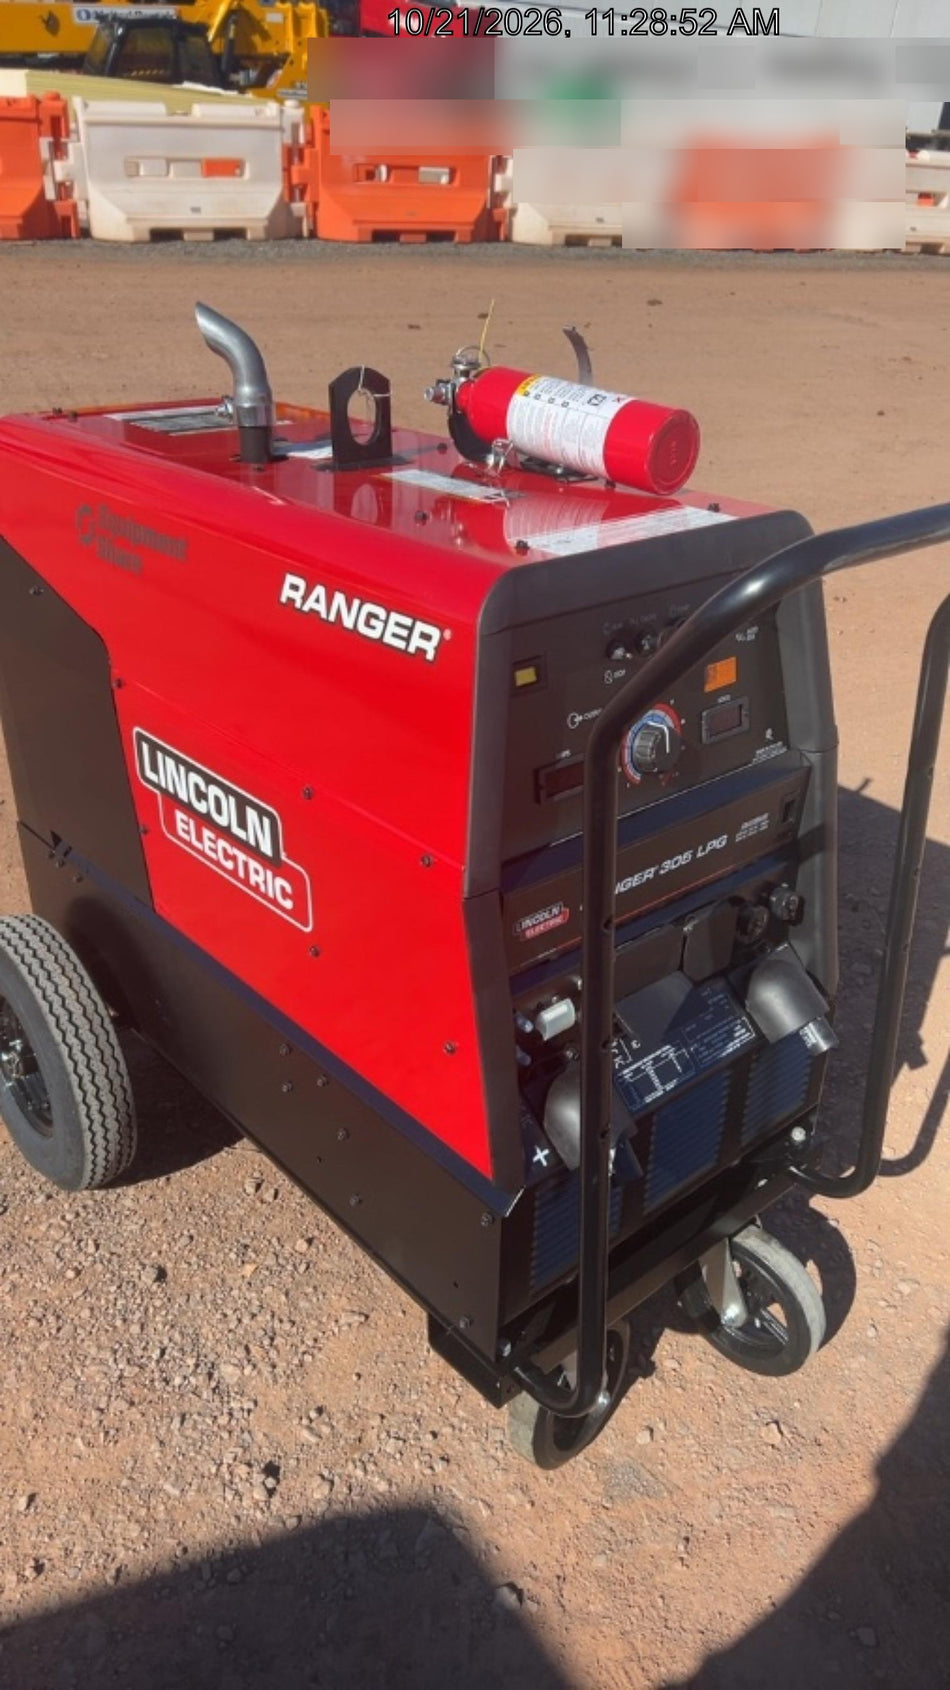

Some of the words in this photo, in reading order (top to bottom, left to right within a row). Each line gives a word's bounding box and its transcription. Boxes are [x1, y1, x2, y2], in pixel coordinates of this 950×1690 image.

[280, 572, 442, 662] RANGER
[141, 740, 273, 858] LINCOLN
[174, 808, 294, 911] ELECTRIC
[659, 849, 693, 875] 305
[696, 834, 729, 858] LPG
